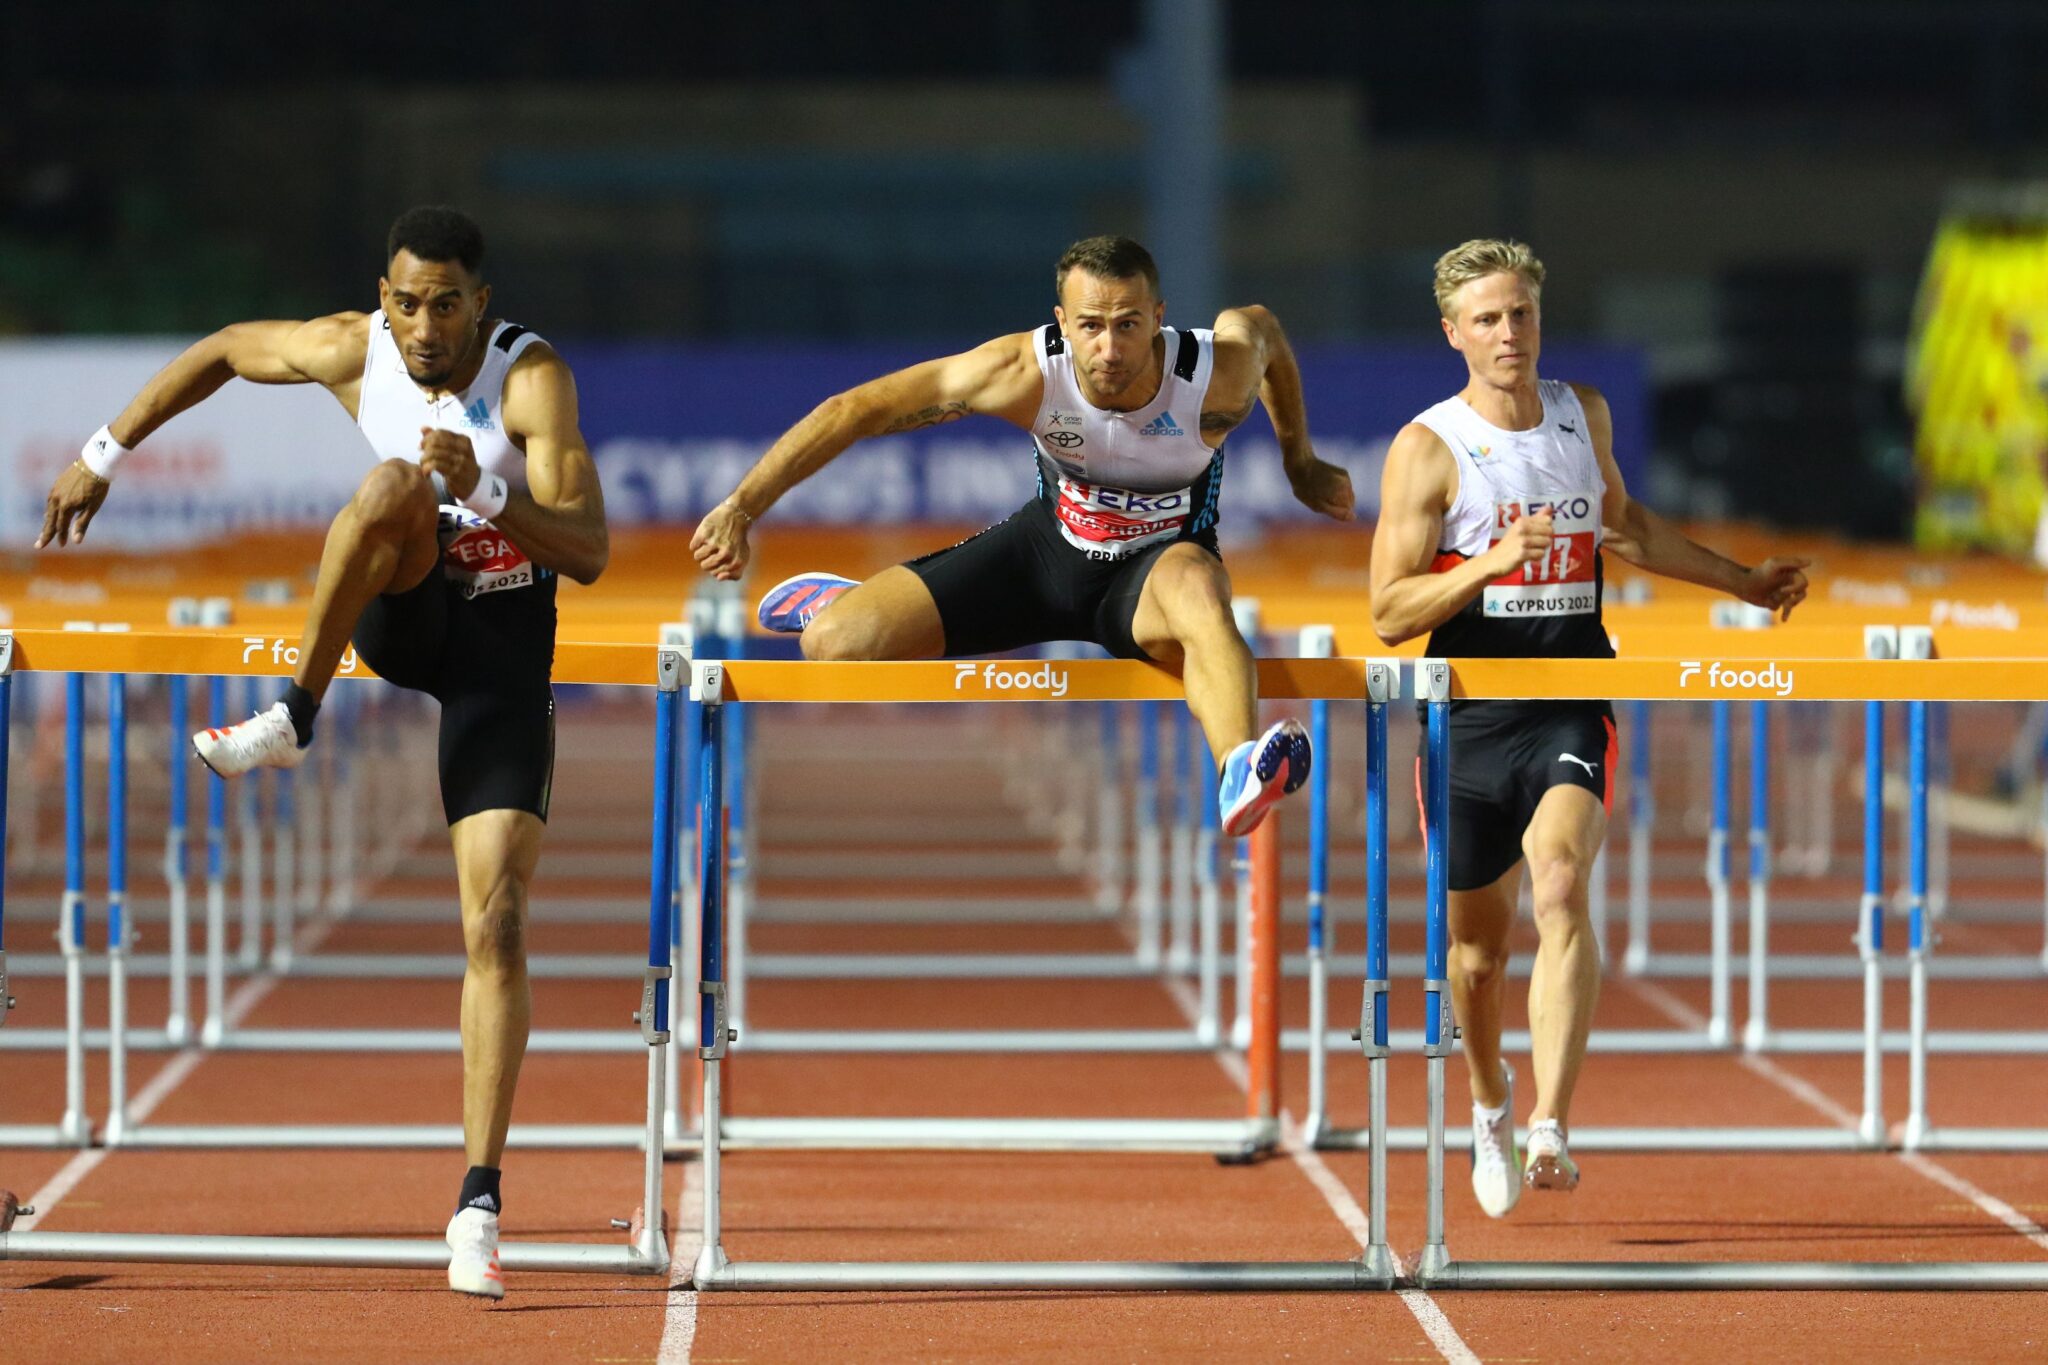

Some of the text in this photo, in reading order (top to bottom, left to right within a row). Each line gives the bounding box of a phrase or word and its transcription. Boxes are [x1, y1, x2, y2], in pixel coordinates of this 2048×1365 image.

[460, 418, 496, 430] adidas
[1139, 427, 1184, 437] adidas
[1097, 486, 1182, 512] EKO
[1528, 497, 1589, 520] EKO
[489, 572, 529, 590] 2022
[1505, 598, 1565, 613] CYPRUS
[271, 638, 357, 674] foy
[983, 663, 1068, 697] foody
[1708, 661, 1793, 696] foody
